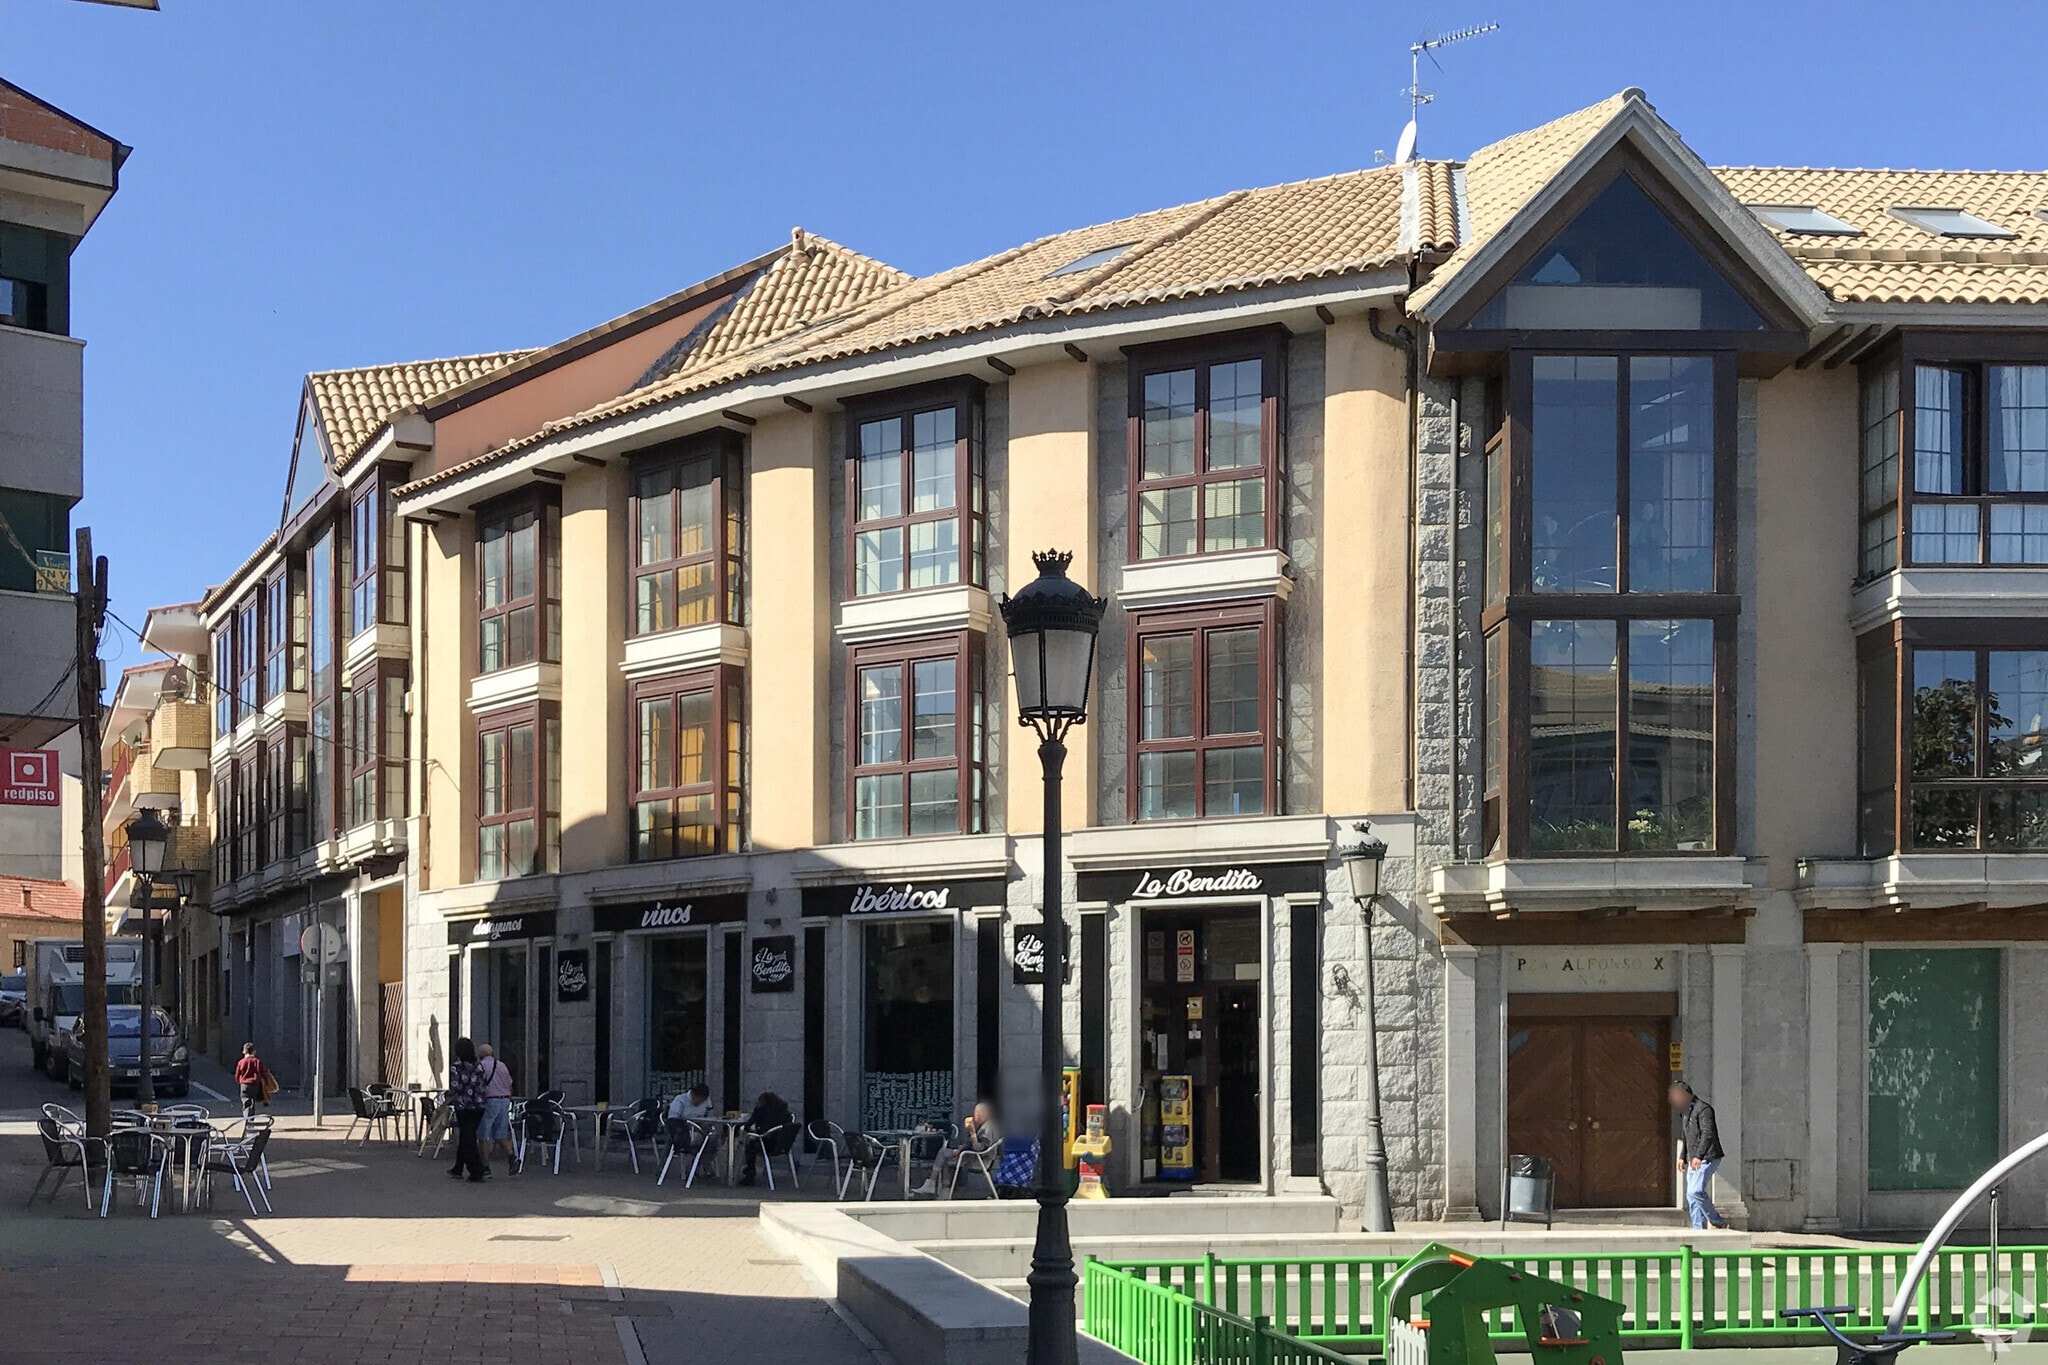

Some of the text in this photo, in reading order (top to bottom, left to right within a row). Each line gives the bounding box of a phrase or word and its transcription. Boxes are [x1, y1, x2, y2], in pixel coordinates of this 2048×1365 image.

[4, 787, 55, 801] redpiso
[1132, 868, 1263, 897] La Bendita
[850, 883, 950, 913] ibéricos
[641, 902, 692, 927] vinos
[473, 918, 523, 940] desayunos
[752, 961, 792, 976] Bendita
[1654, 957, 1664, 970] X
